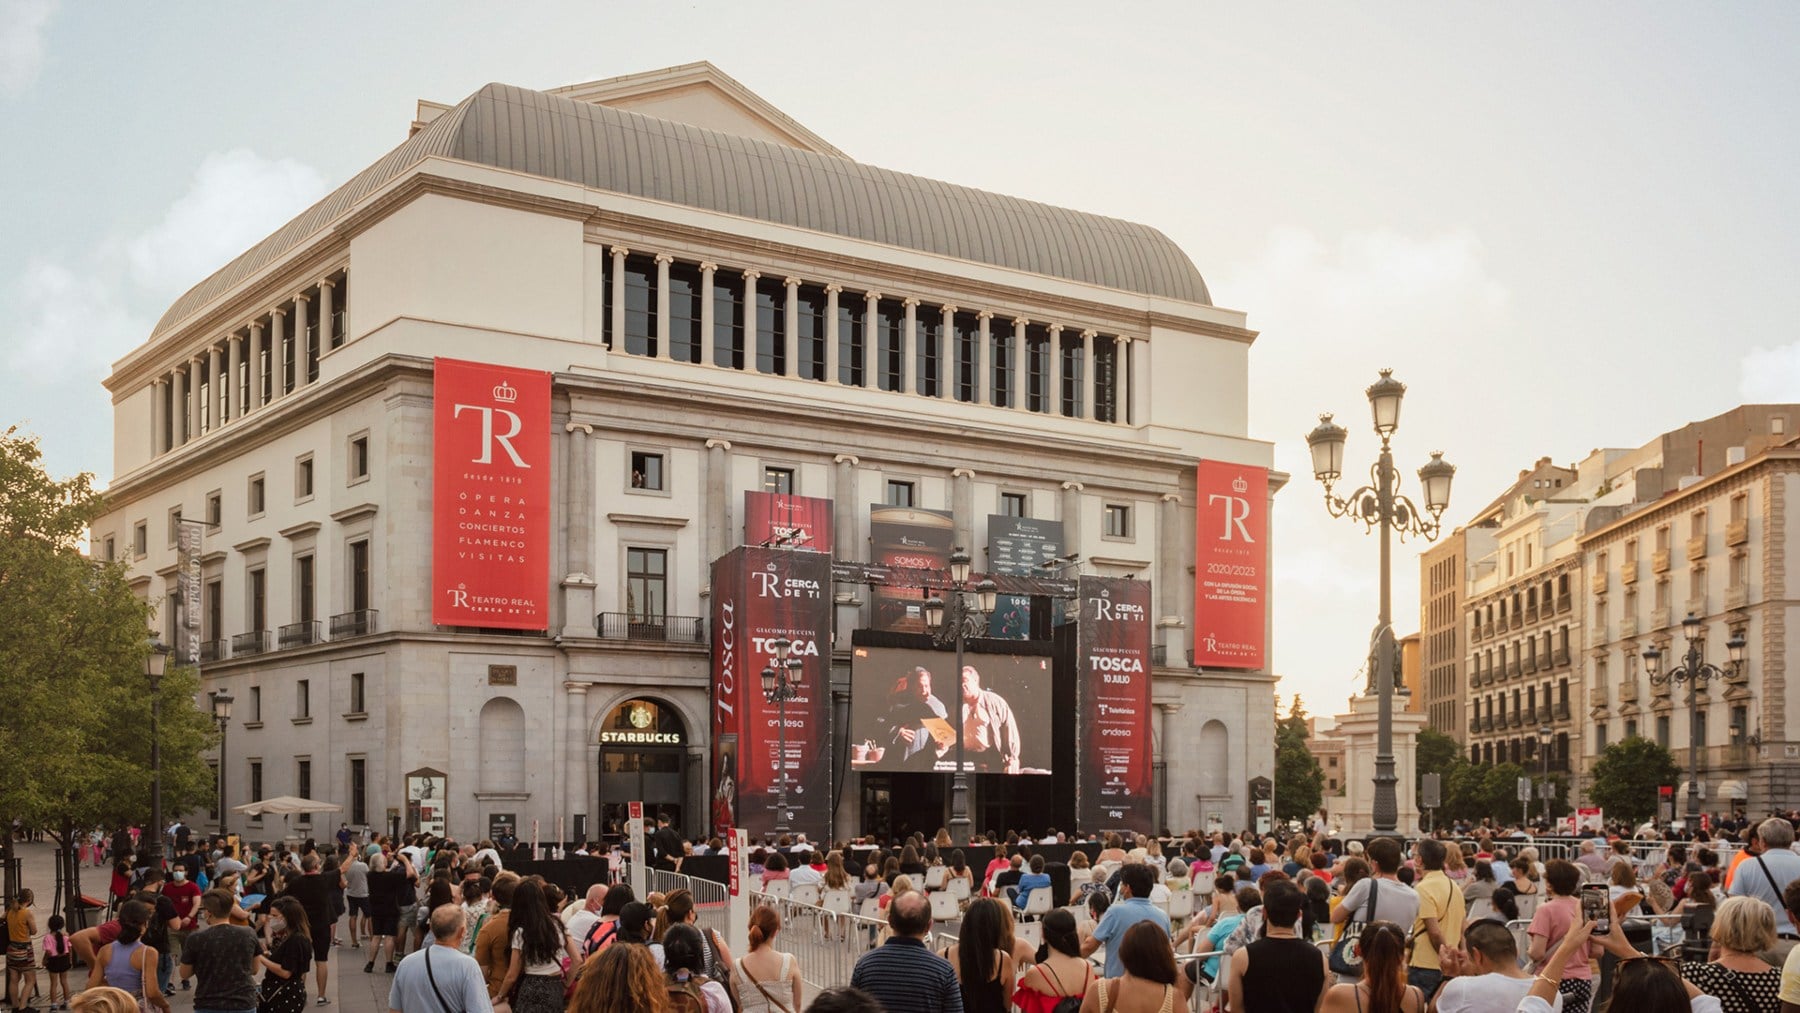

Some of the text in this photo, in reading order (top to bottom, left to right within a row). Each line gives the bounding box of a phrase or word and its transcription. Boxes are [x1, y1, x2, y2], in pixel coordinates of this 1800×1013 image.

[460, 507, 525, 520] DANZA
[460, 522, 525, 534] CONCIERTOS
[460, 536, 525, 548] FLAMENCO
[460, 552, 525, 563] VISITAS
[894, 556, 924, 567] SOMOS
[1207, 563, 1256, 576] 2020/2023
[784, 578, 820, 589] CERCA
[784, 589, 820, 599] DE TI
[472, 596, 535, 607] TEATRO REAL
[1116, 604, 1144, 613] CERCA
[752, 638, 819, 656] TOCA
[717, 598, 734, 723] Tosca
[1090, 656, 1144, 672] TOSCA
[1104, 674, 1130, 684] 10 JULIO
[601, 732, 680, 743] STARBUCKS
[1102, 728, 1131, 736] endesa
